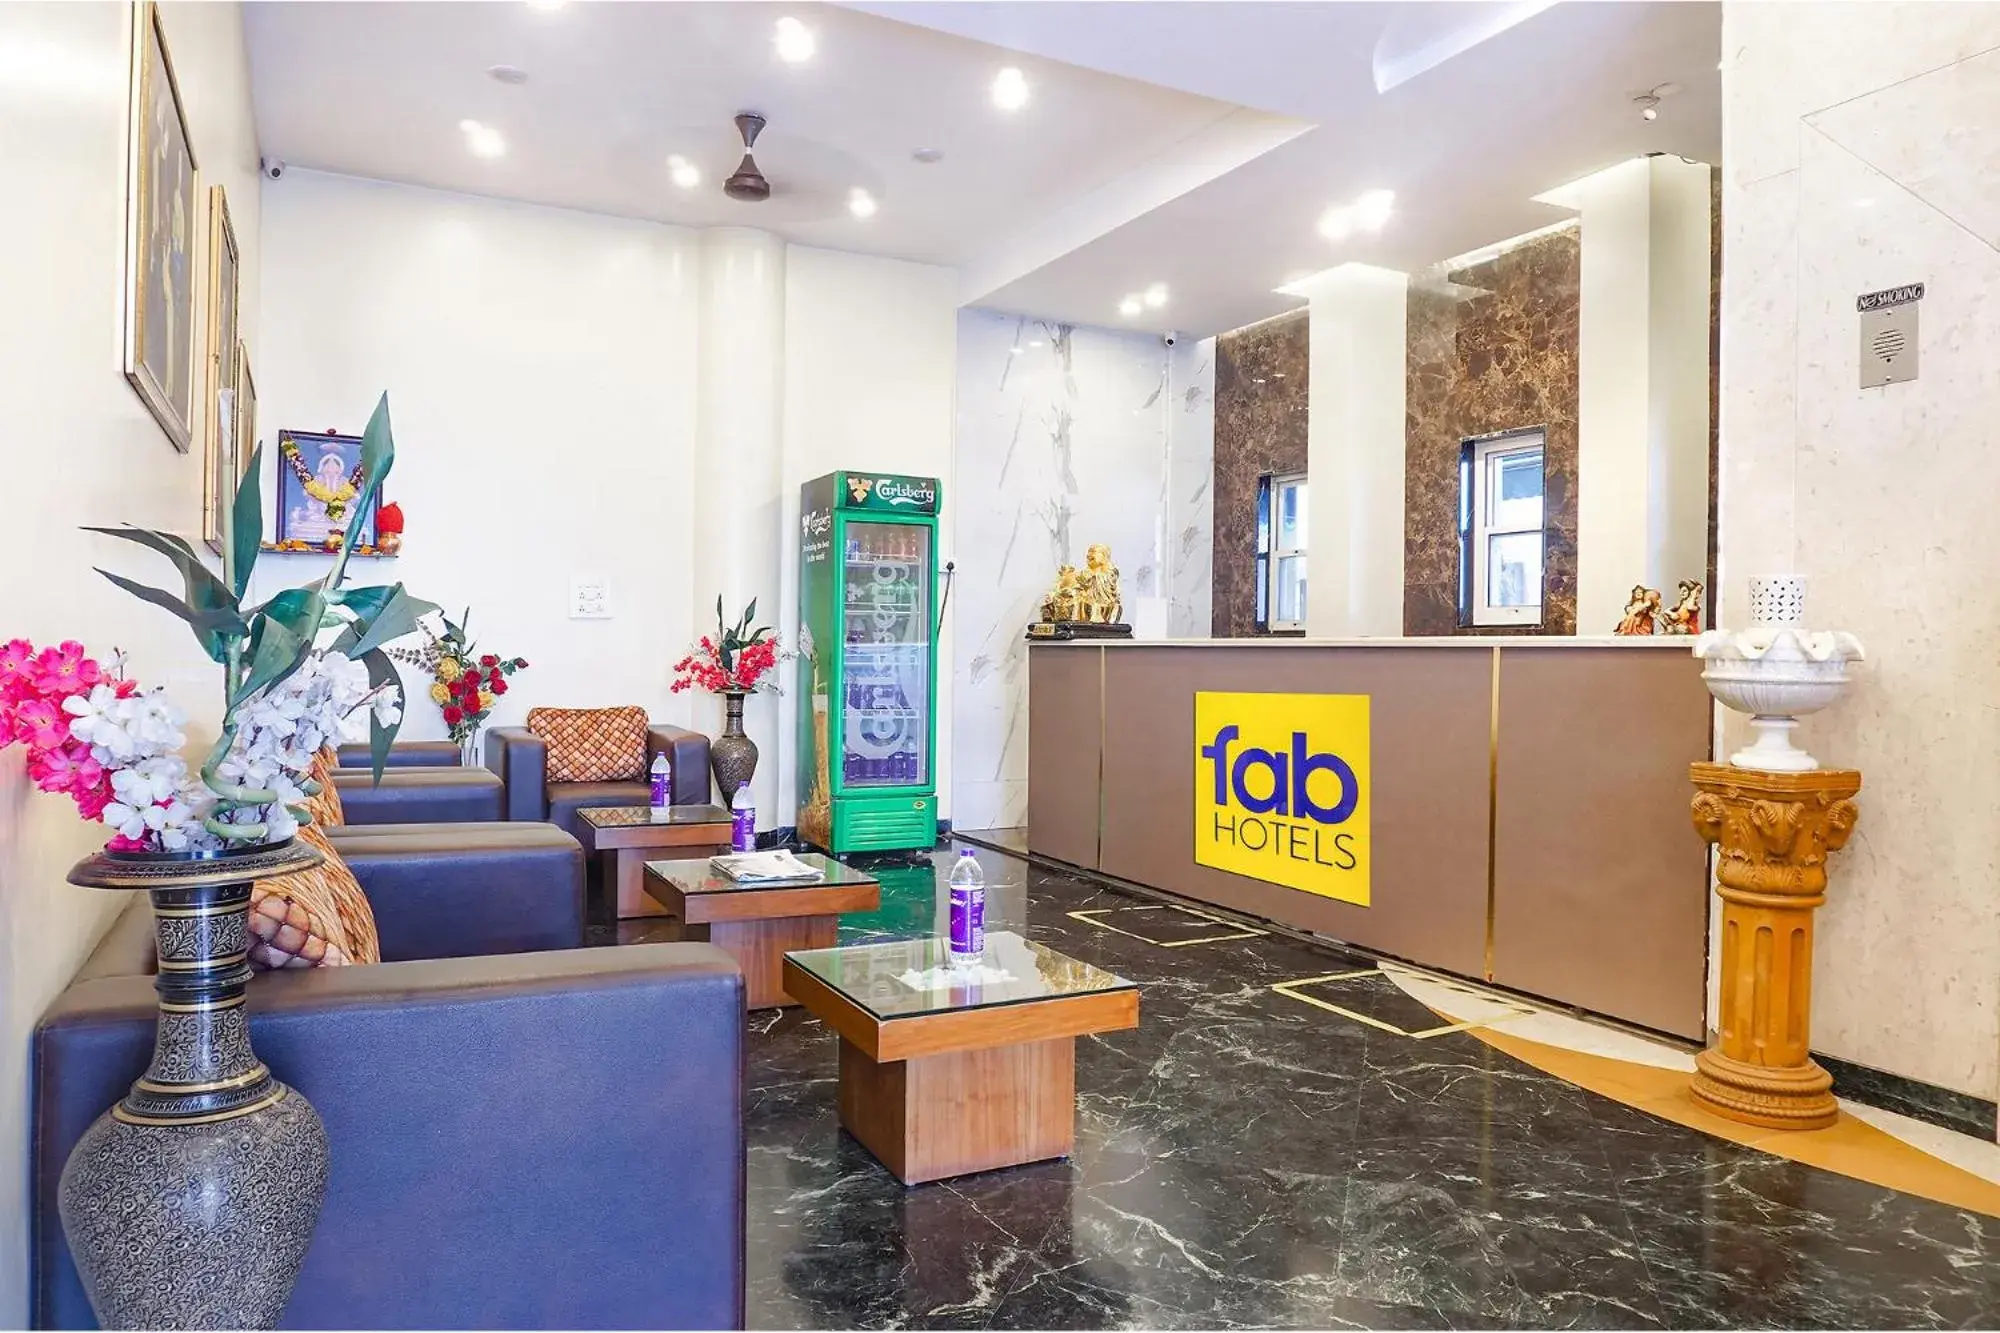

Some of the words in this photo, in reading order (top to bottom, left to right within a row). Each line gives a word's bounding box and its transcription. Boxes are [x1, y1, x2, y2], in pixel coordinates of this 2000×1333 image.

[1877, 284, 1921, 305] SMOKING
[875, 479, 935, 503] Carlsberg
[845, 560, 910, 760] Carlsberg
[1202, 724, 1359, 825] fab
[1214, 812, 1356, 870] HOTELS
